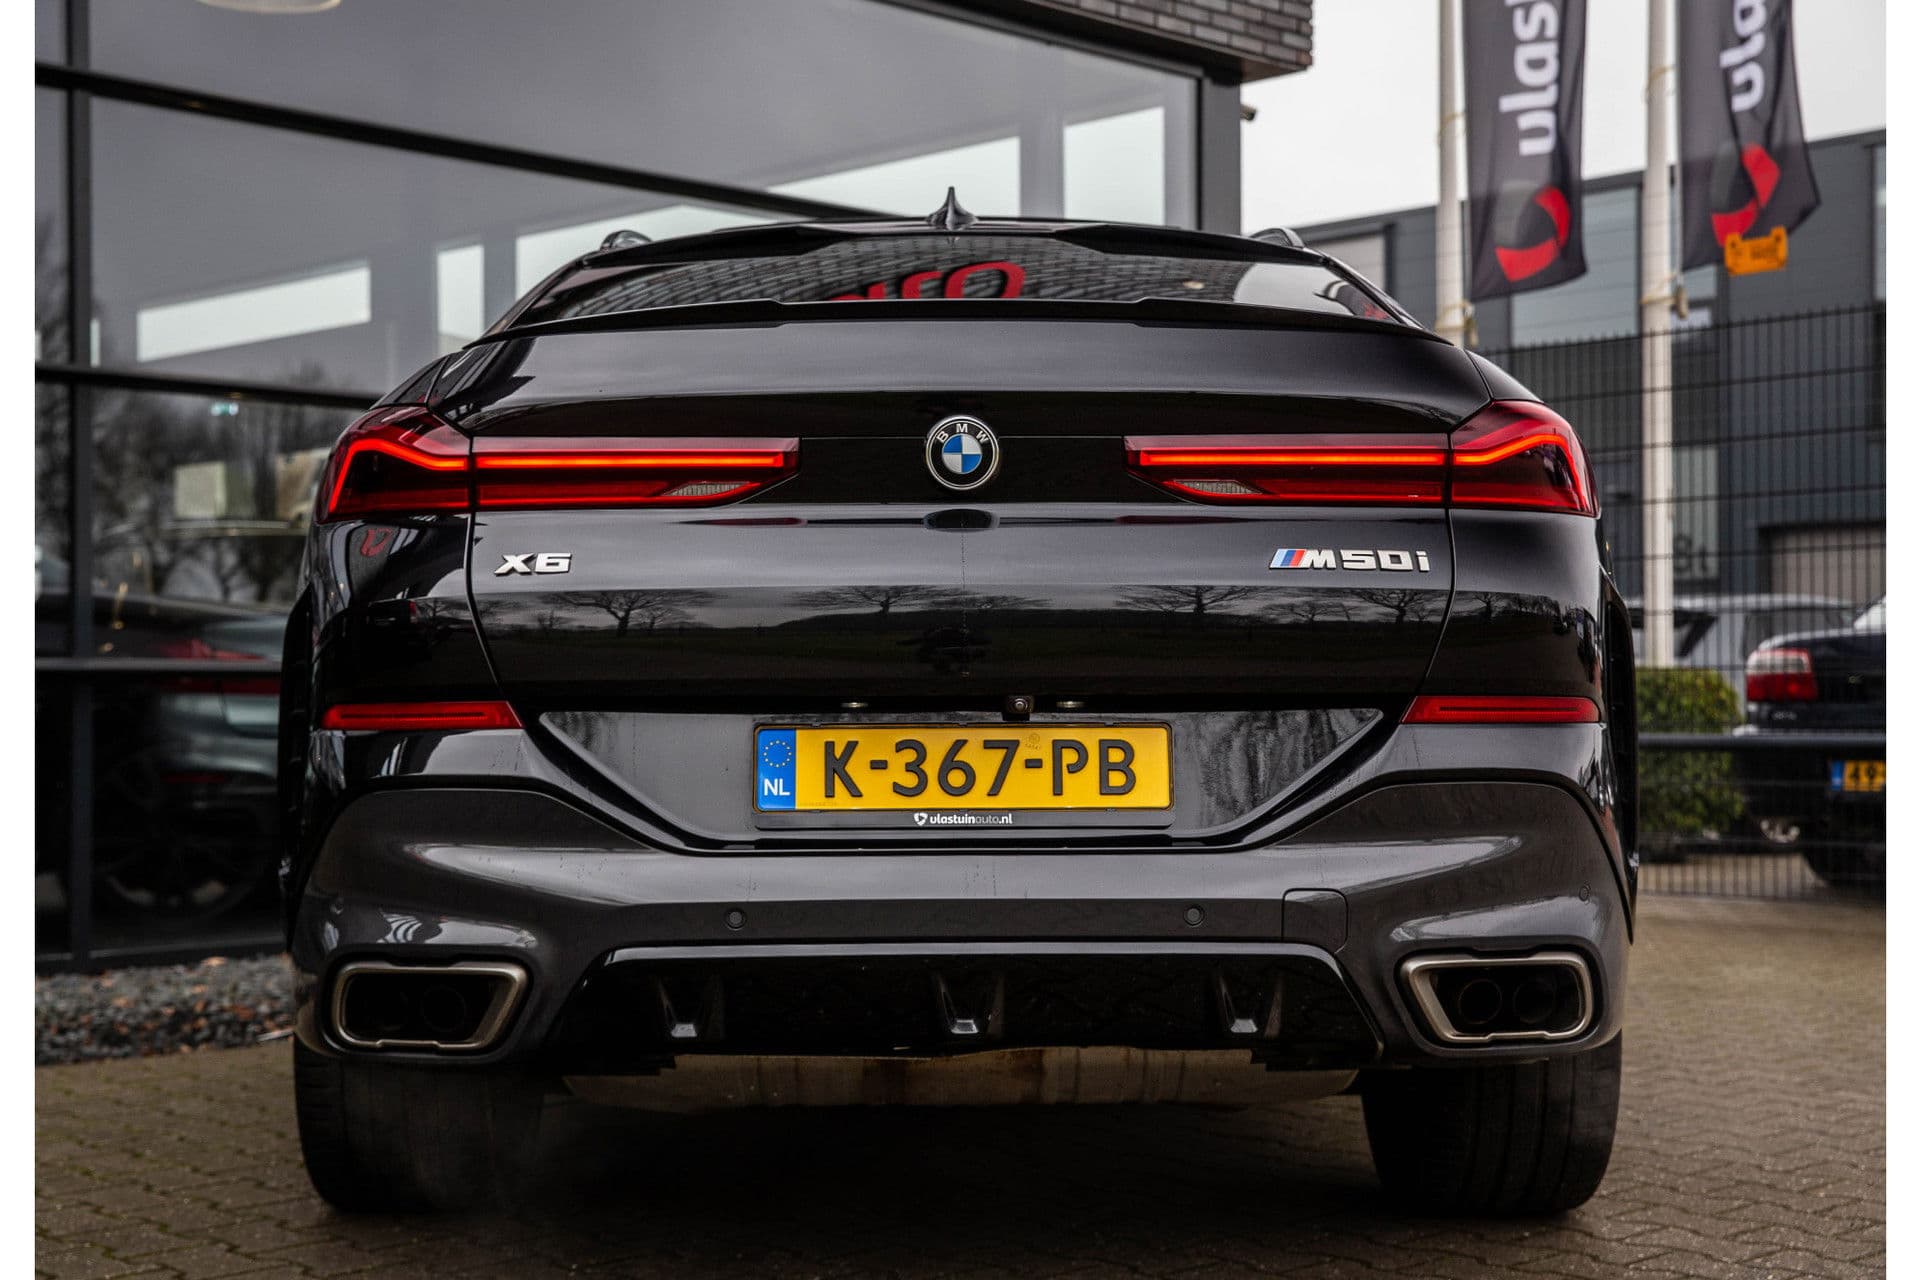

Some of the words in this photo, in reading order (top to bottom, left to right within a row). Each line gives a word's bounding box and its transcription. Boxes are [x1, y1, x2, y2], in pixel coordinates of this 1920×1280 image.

[935, 423, 989, 444] BMW
[494, 552, 572, 576] X6
[1299, 548, 1431, 572] M50i
[823, 738, 1137, 798] K-367-PB
[763, 778, 791, 797] NL
